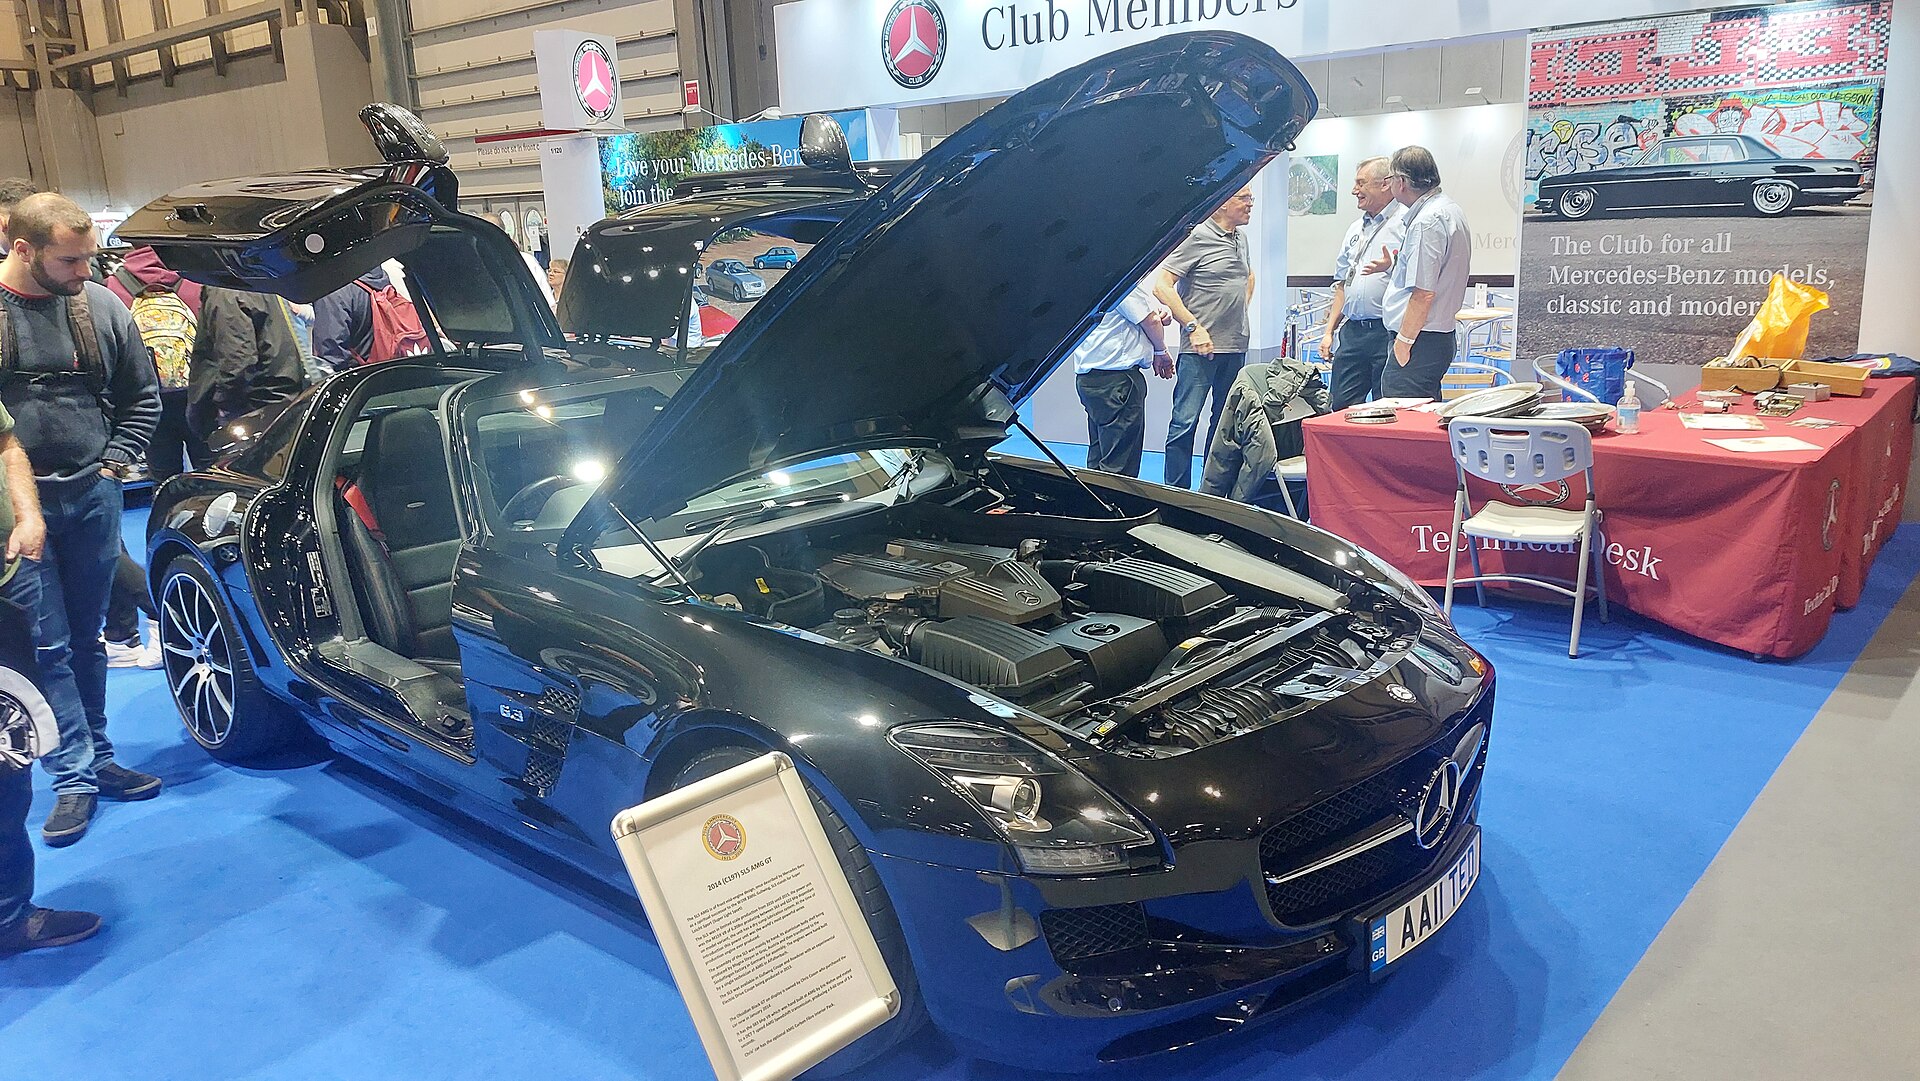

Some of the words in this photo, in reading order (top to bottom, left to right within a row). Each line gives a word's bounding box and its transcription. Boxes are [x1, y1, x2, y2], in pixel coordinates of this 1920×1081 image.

[982, 0, 1069, 50] Club
[615, 157, 648, 178] Love
[652, 155, 687, 180] your
[690, 144, 802, 174] Mercedes-Ben
[618, 182, 647, 208] Join
[650, 182, 674, 203] the
[1550, 236, 1592, 255] The
[1598, 234, 1653, 254] Club
[1660, 233, 1695, 254] for
[1700, 232, 1732, 253] all
[1548, 264, 1726, 285] Mercedes-Benz
[1546, 295, 1622, 316] classic
[1629, 295, 1672, 316] and
[1678, 295, 1764, 316] moder
[500, 704, 524, 722] 6.3
[707, 880, 722, 891] 2014
[721, 871, 740, 885] (C197)
[739, 866, 750, 875] SLS
[749, 860, 764, 871] AMG
[1400, 882, 1444, 950] AA11
[1448, 844, 1474, 908] TED
[1372, 946, 1384, 962] GB
